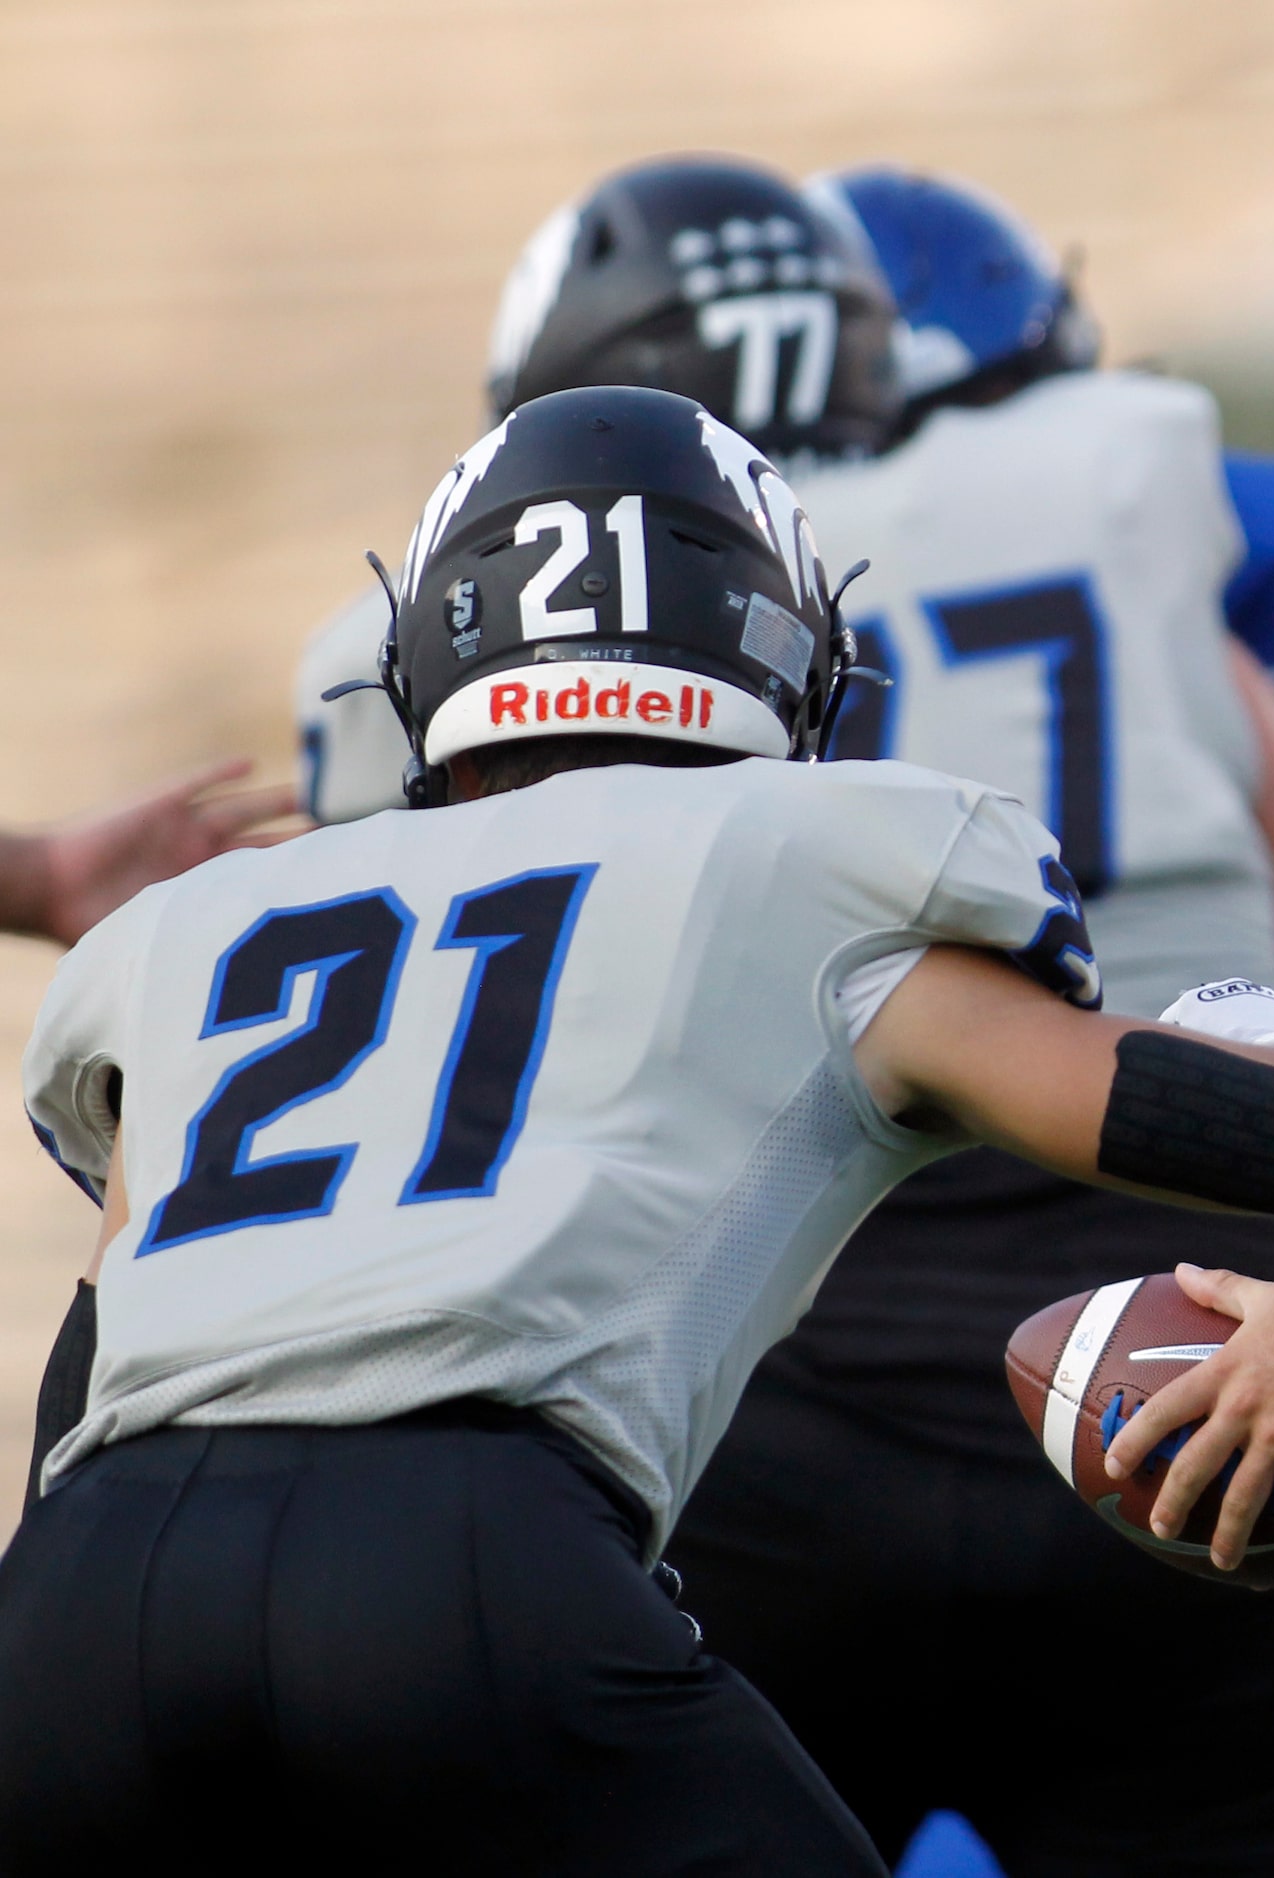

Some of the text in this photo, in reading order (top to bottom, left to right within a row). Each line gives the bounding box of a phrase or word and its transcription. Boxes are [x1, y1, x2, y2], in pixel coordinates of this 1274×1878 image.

[703, 290, 838, 430] 77
[513, 495, 649, 641] 21
[581, 647, 634, 660] WHITE
[490, 677, 714, 730] Riddell
[1207, 981, 1274, 998] BAN
[134, 862, 600, 1259] 21
